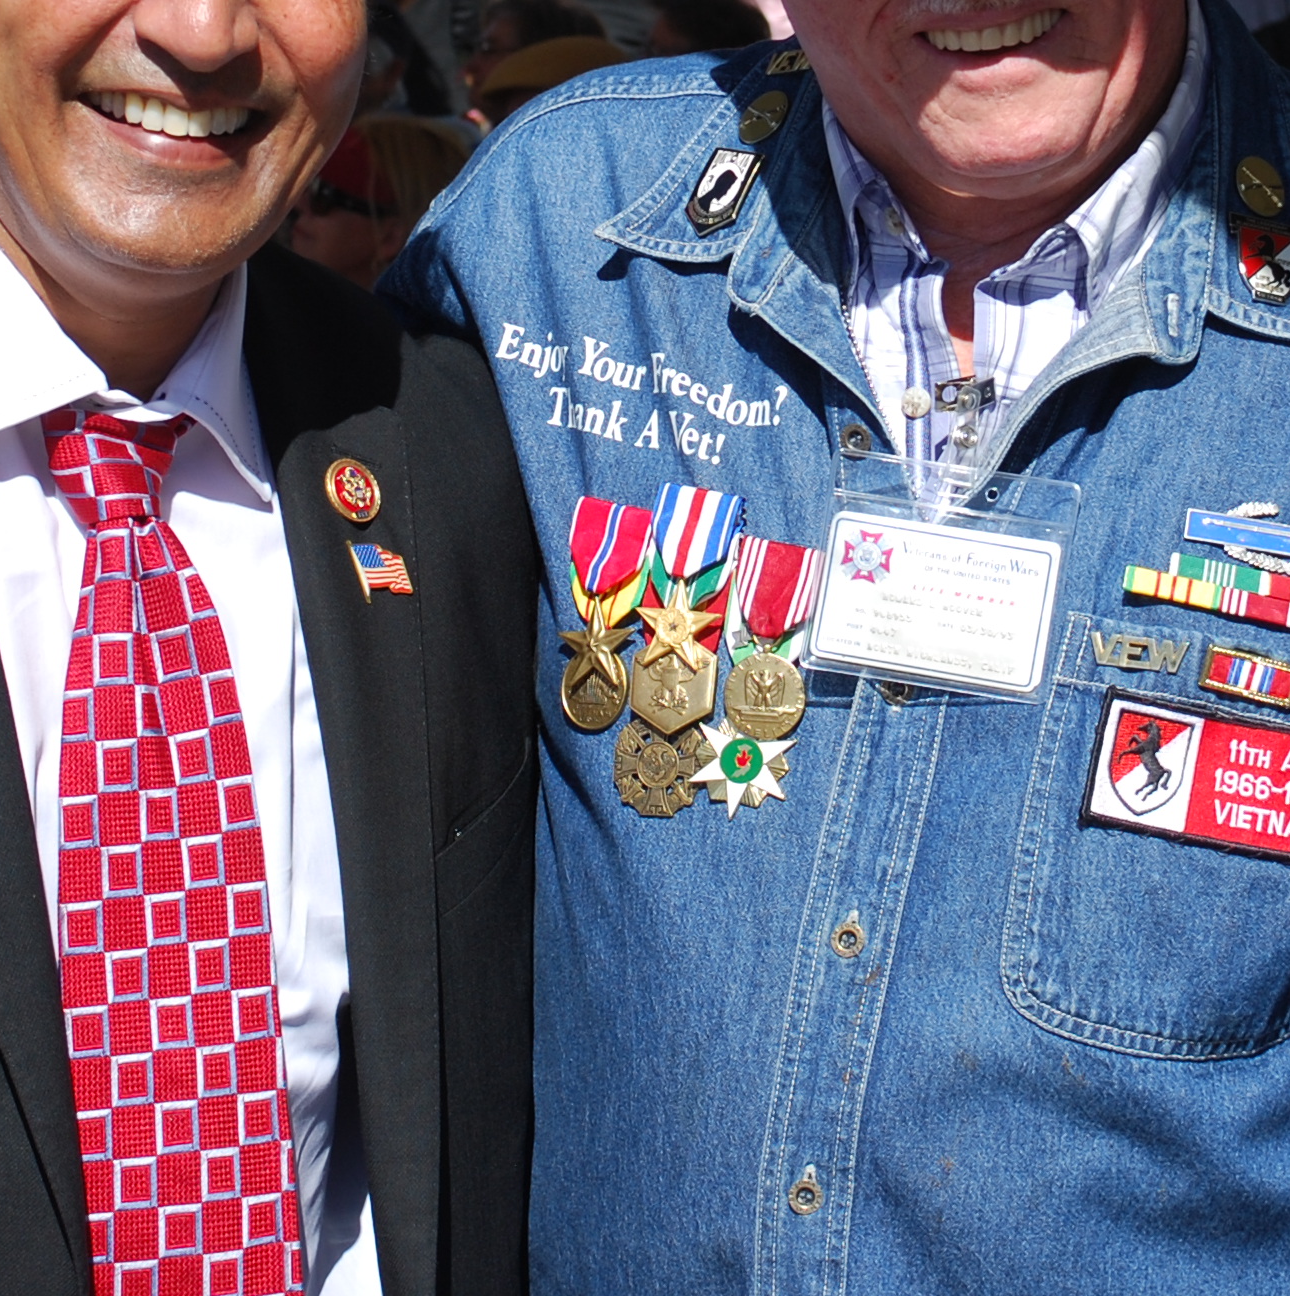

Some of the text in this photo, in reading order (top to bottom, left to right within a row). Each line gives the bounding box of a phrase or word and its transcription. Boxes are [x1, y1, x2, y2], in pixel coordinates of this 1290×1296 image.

[495, 323, 788, 427] Enjoy Your Freedom?
[547, 386, 726, 465] Thank A Vet!
[903, 541, 948, 562] Veterans
[966, 552, 1007, 572] Foreign
[1009, 559, 1040, 577] Wars
[937, 567, 951, 575] THE
[953, 570, 981, 581] UNITED
[983, 575, 1011, 585] STATES
[1229, 738, 1273, 770] 11TH
